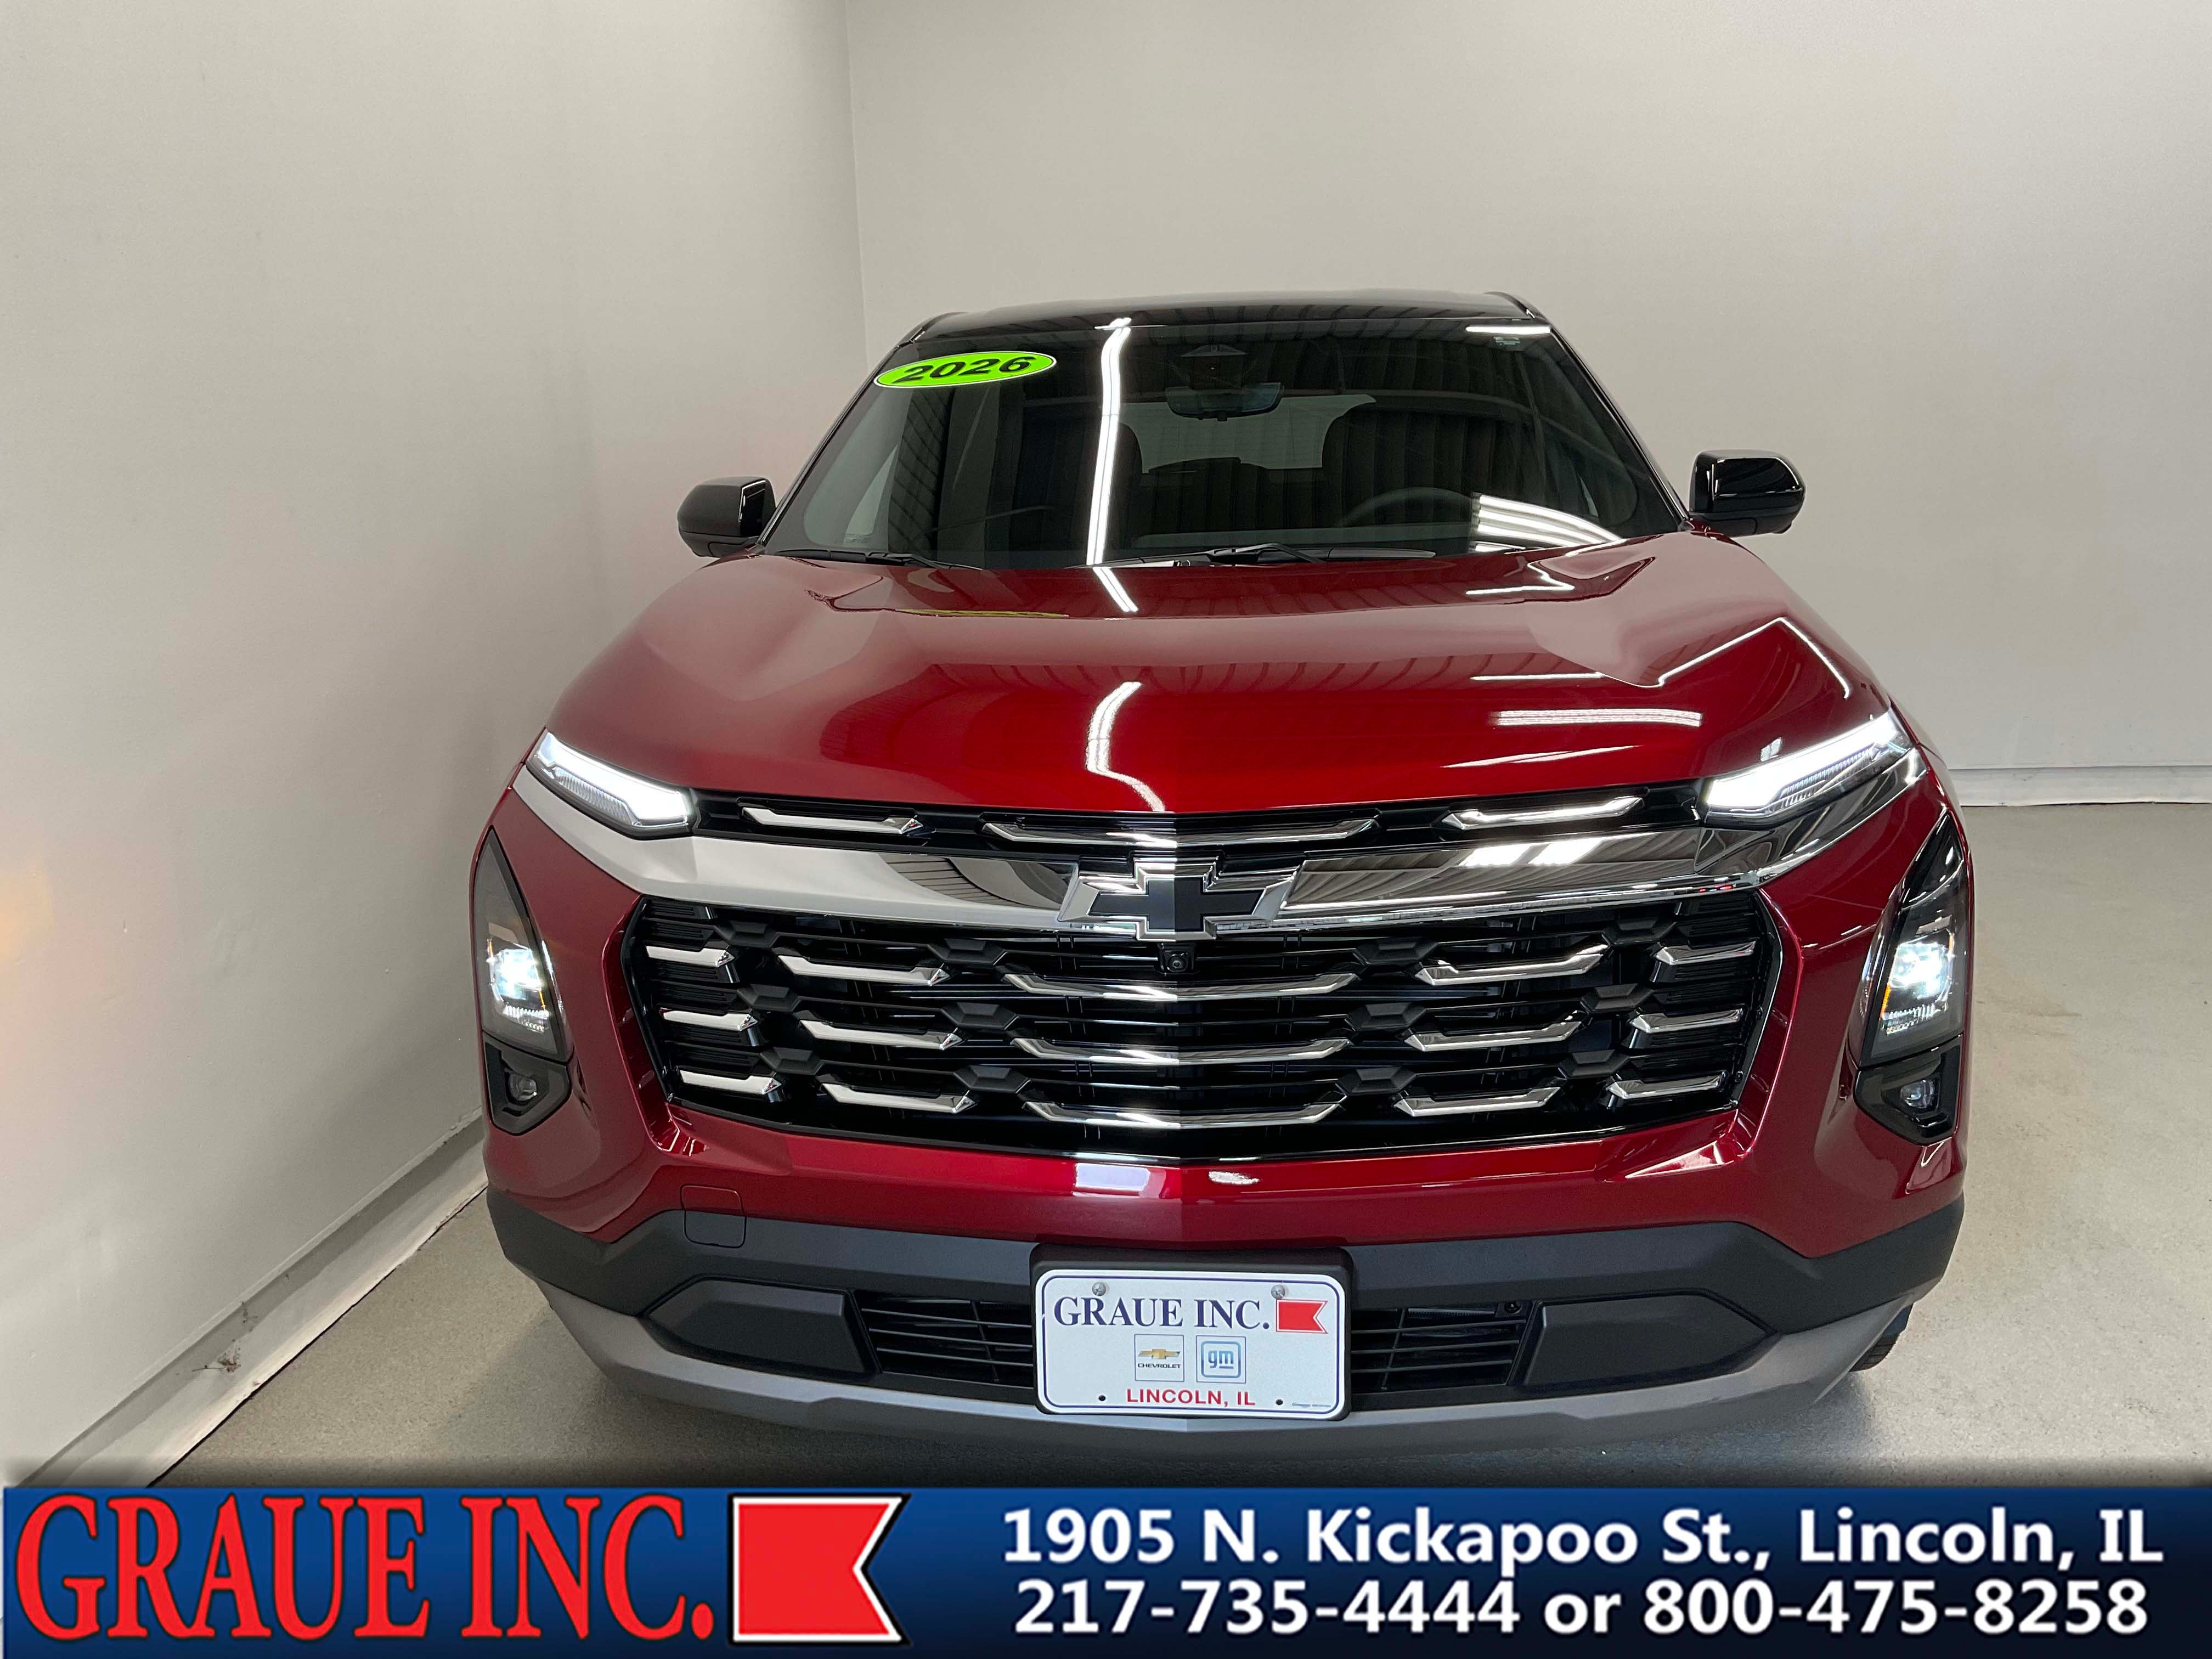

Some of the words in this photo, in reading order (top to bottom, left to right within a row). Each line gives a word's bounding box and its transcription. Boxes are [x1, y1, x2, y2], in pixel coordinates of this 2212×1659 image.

[893, 356, 1036, 383] 2026
[1053, 1296, 1183, 1327] GRAUE
[1193, 1299, 1269, 1330] INC.
[1126, 1389, 1228, 1407] LINCOLN,
[1237, 1392, 1256, 1406] IL
